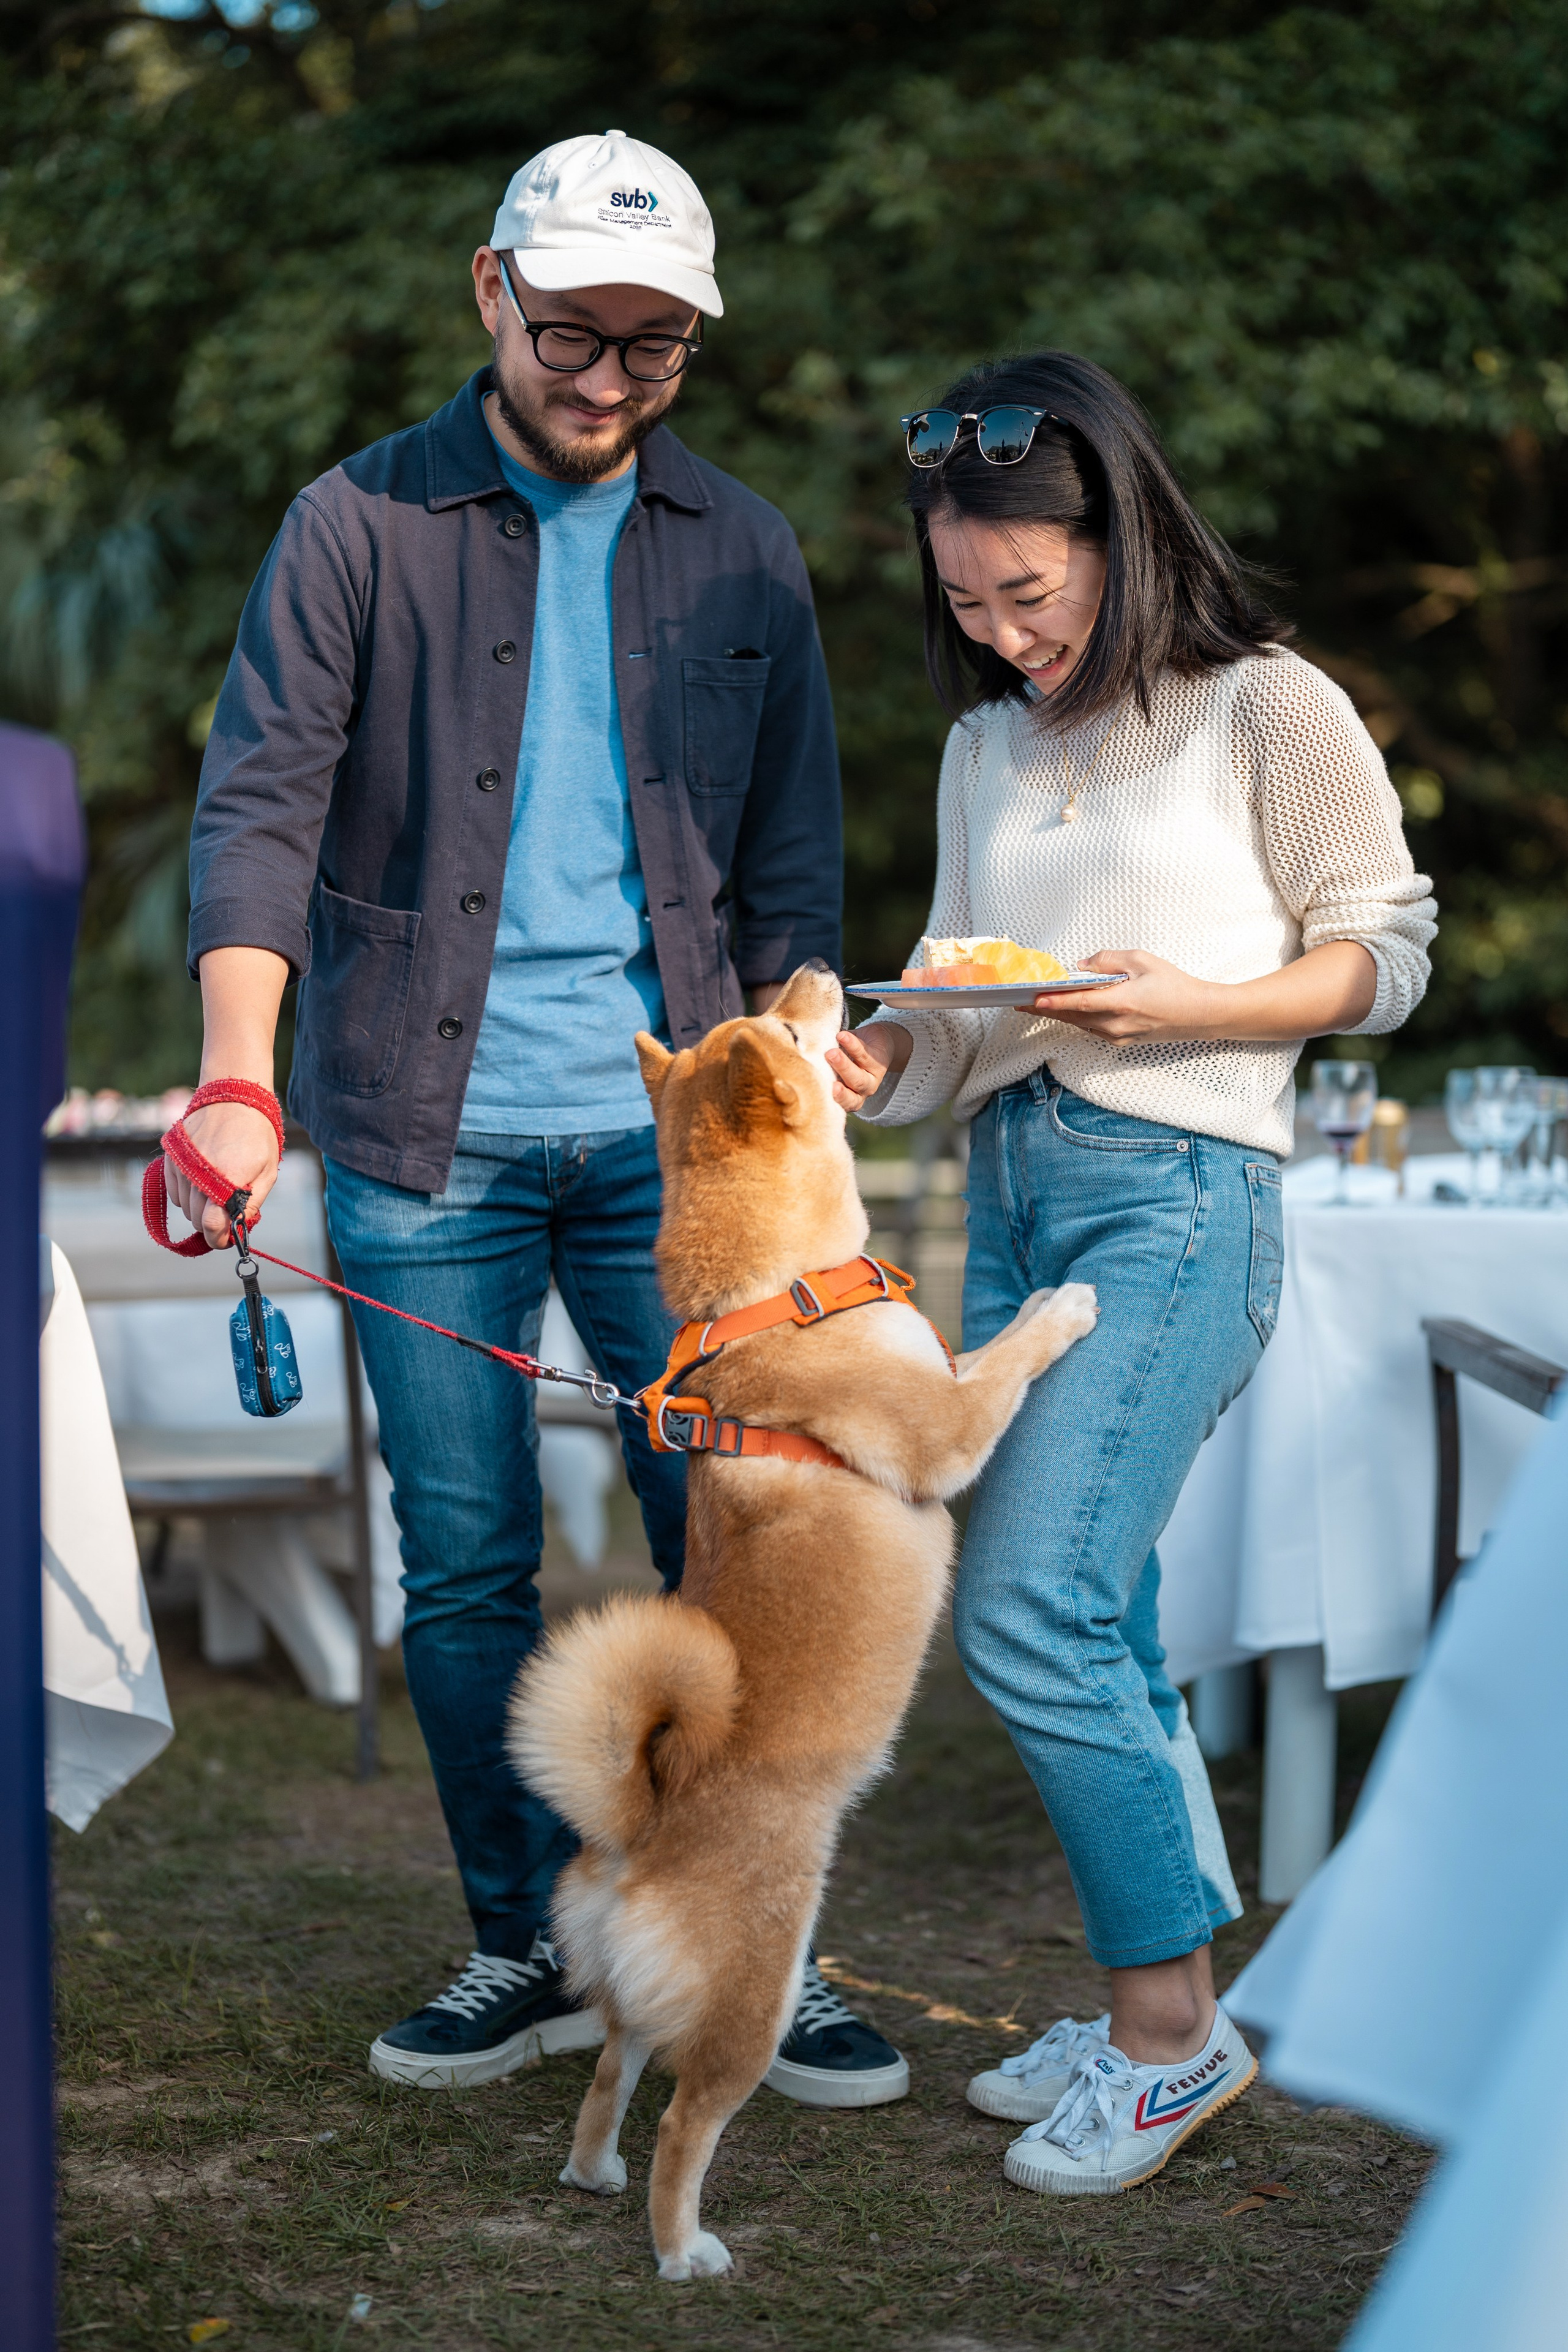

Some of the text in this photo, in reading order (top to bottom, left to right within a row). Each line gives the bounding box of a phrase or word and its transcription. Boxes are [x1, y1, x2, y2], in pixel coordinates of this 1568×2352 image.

[610, 188, 647, 209] svb
[598, 208, 624, 218] Silicon
[626, 212, 649, 221] Valley
[1166, 2049, 1227, 2094] FEIYUE
